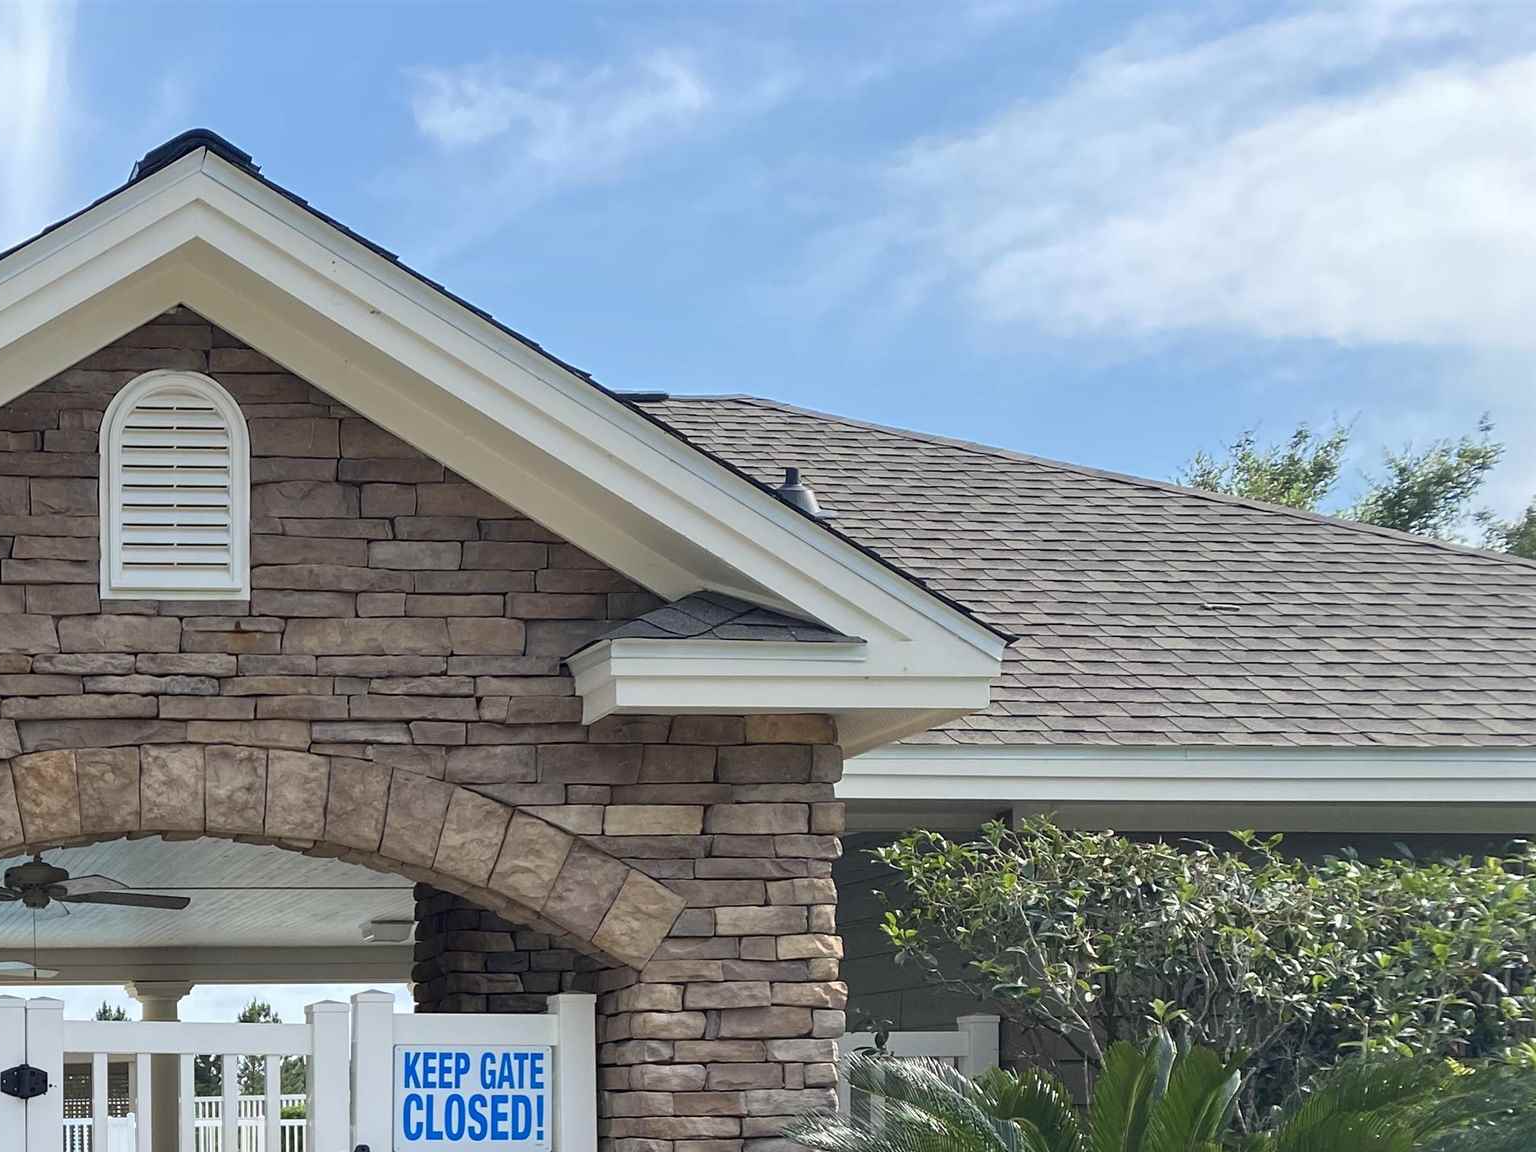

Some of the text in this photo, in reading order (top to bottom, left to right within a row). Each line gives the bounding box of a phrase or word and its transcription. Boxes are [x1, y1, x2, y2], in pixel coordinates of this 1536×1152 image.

[404, 1052, 545, 1089] KEEP GATE
[403, 1094, 545, 1141] CLOSED!
